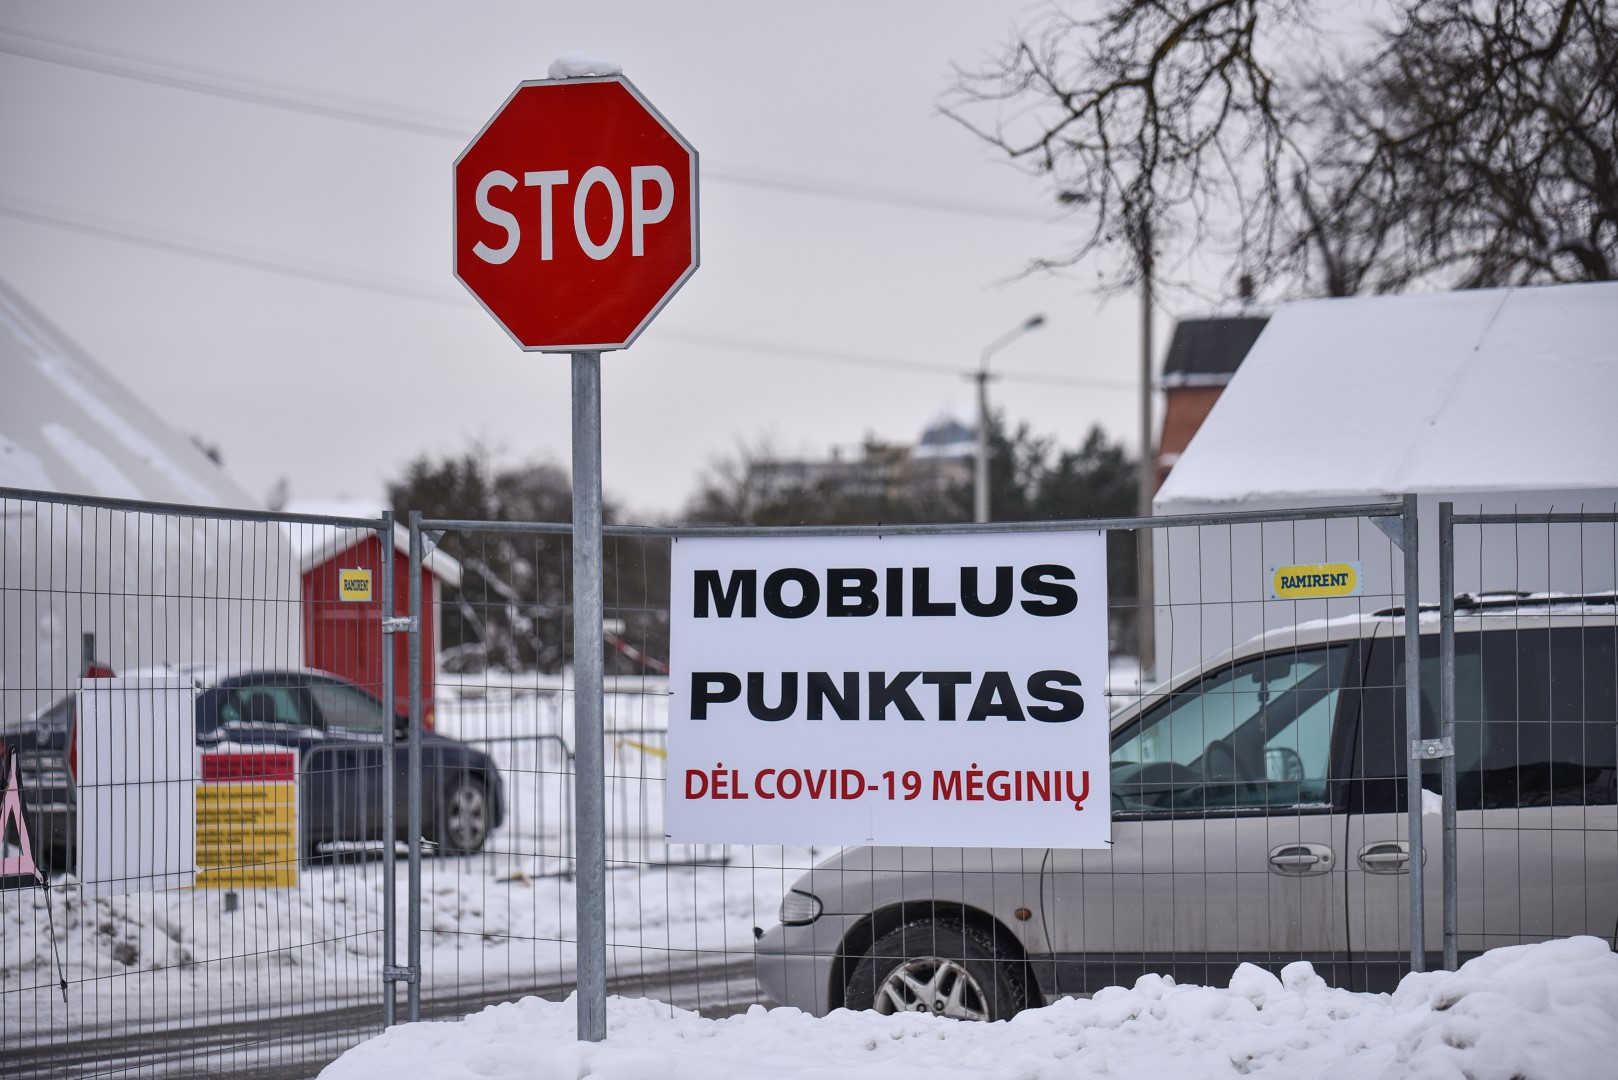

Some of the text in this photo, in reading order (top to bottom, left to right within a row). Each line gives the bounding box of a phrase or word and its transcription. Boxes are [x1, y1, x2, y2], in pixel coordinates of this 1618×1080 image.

[472, 165, 675, 265] STOP
[343, 578, 369, 592] RAMIRENT
[693, 563, 1079, 620] MOBILUS
[1280, 572, 1349, 590] RAMIRENT
[690, 669, 1085, 724] PUNKTAS
[684, 761, 1090, 812] DĖL COVID-19 MĖGINIŲ
